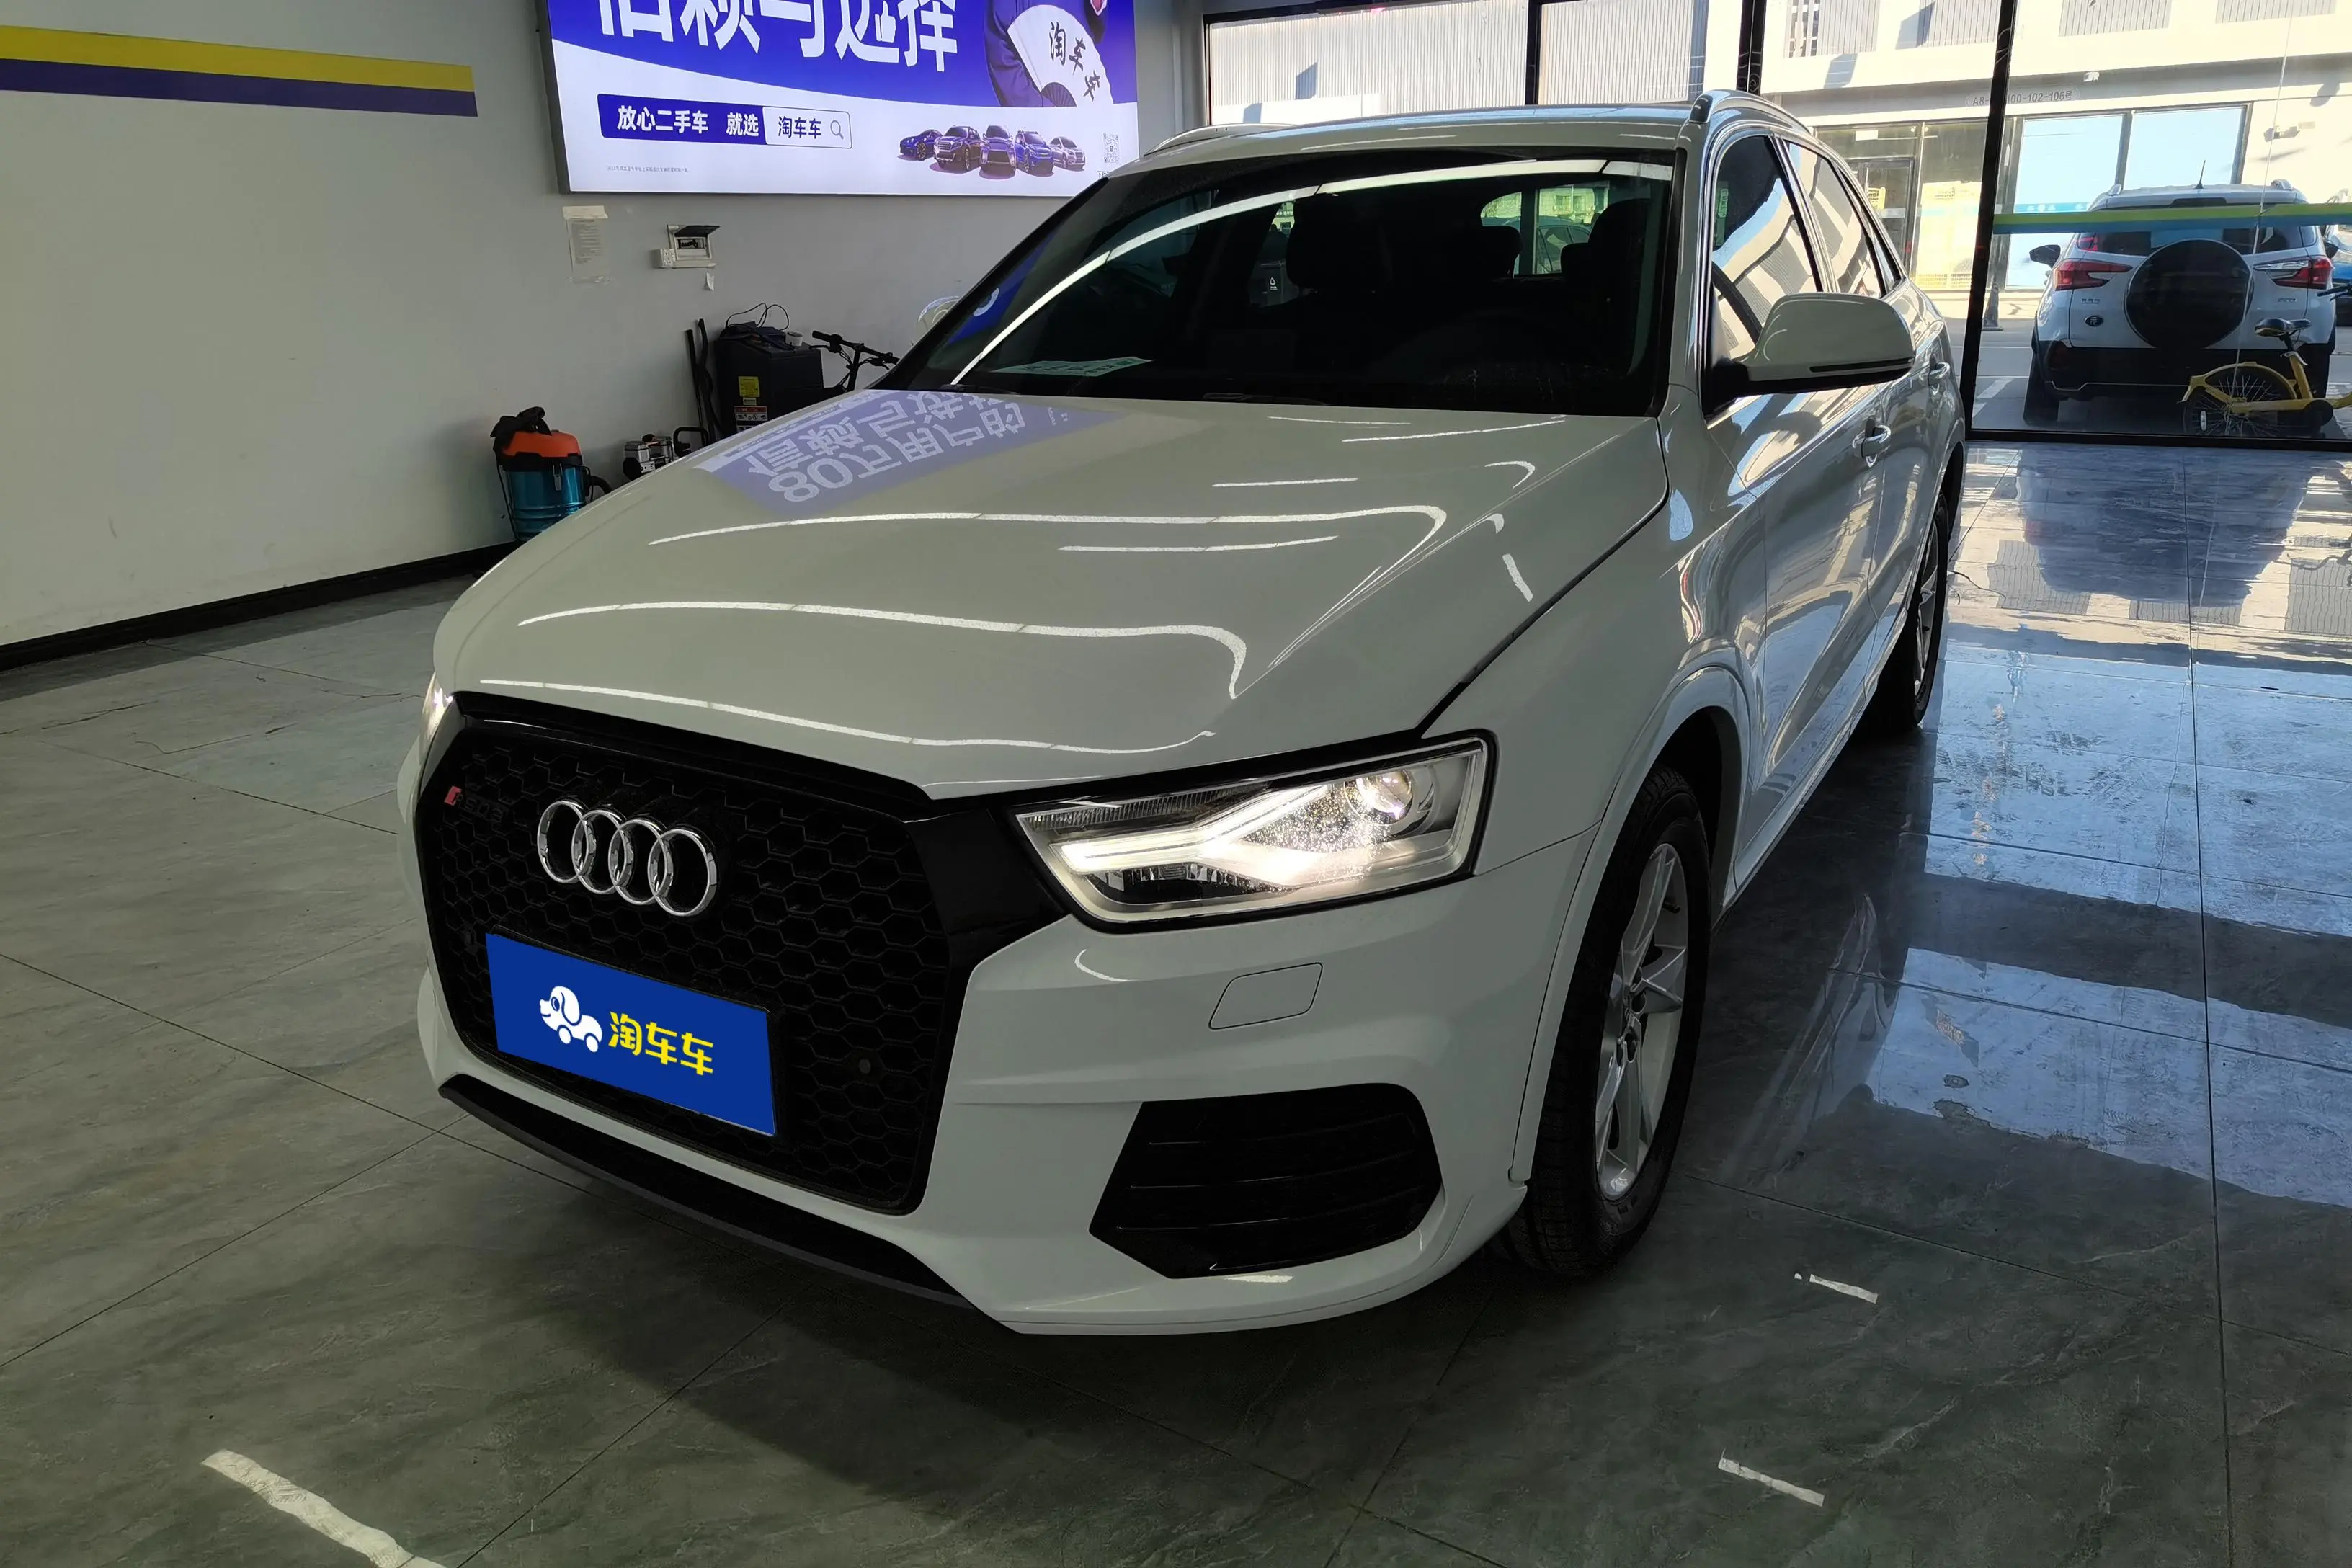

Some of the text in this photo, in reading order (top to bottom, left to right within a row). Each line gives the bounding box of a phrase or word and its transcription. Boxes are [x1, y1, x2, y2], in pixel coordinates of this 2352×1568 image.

[617, 105, 822, 139] 放心二手车 就选 淘车车
